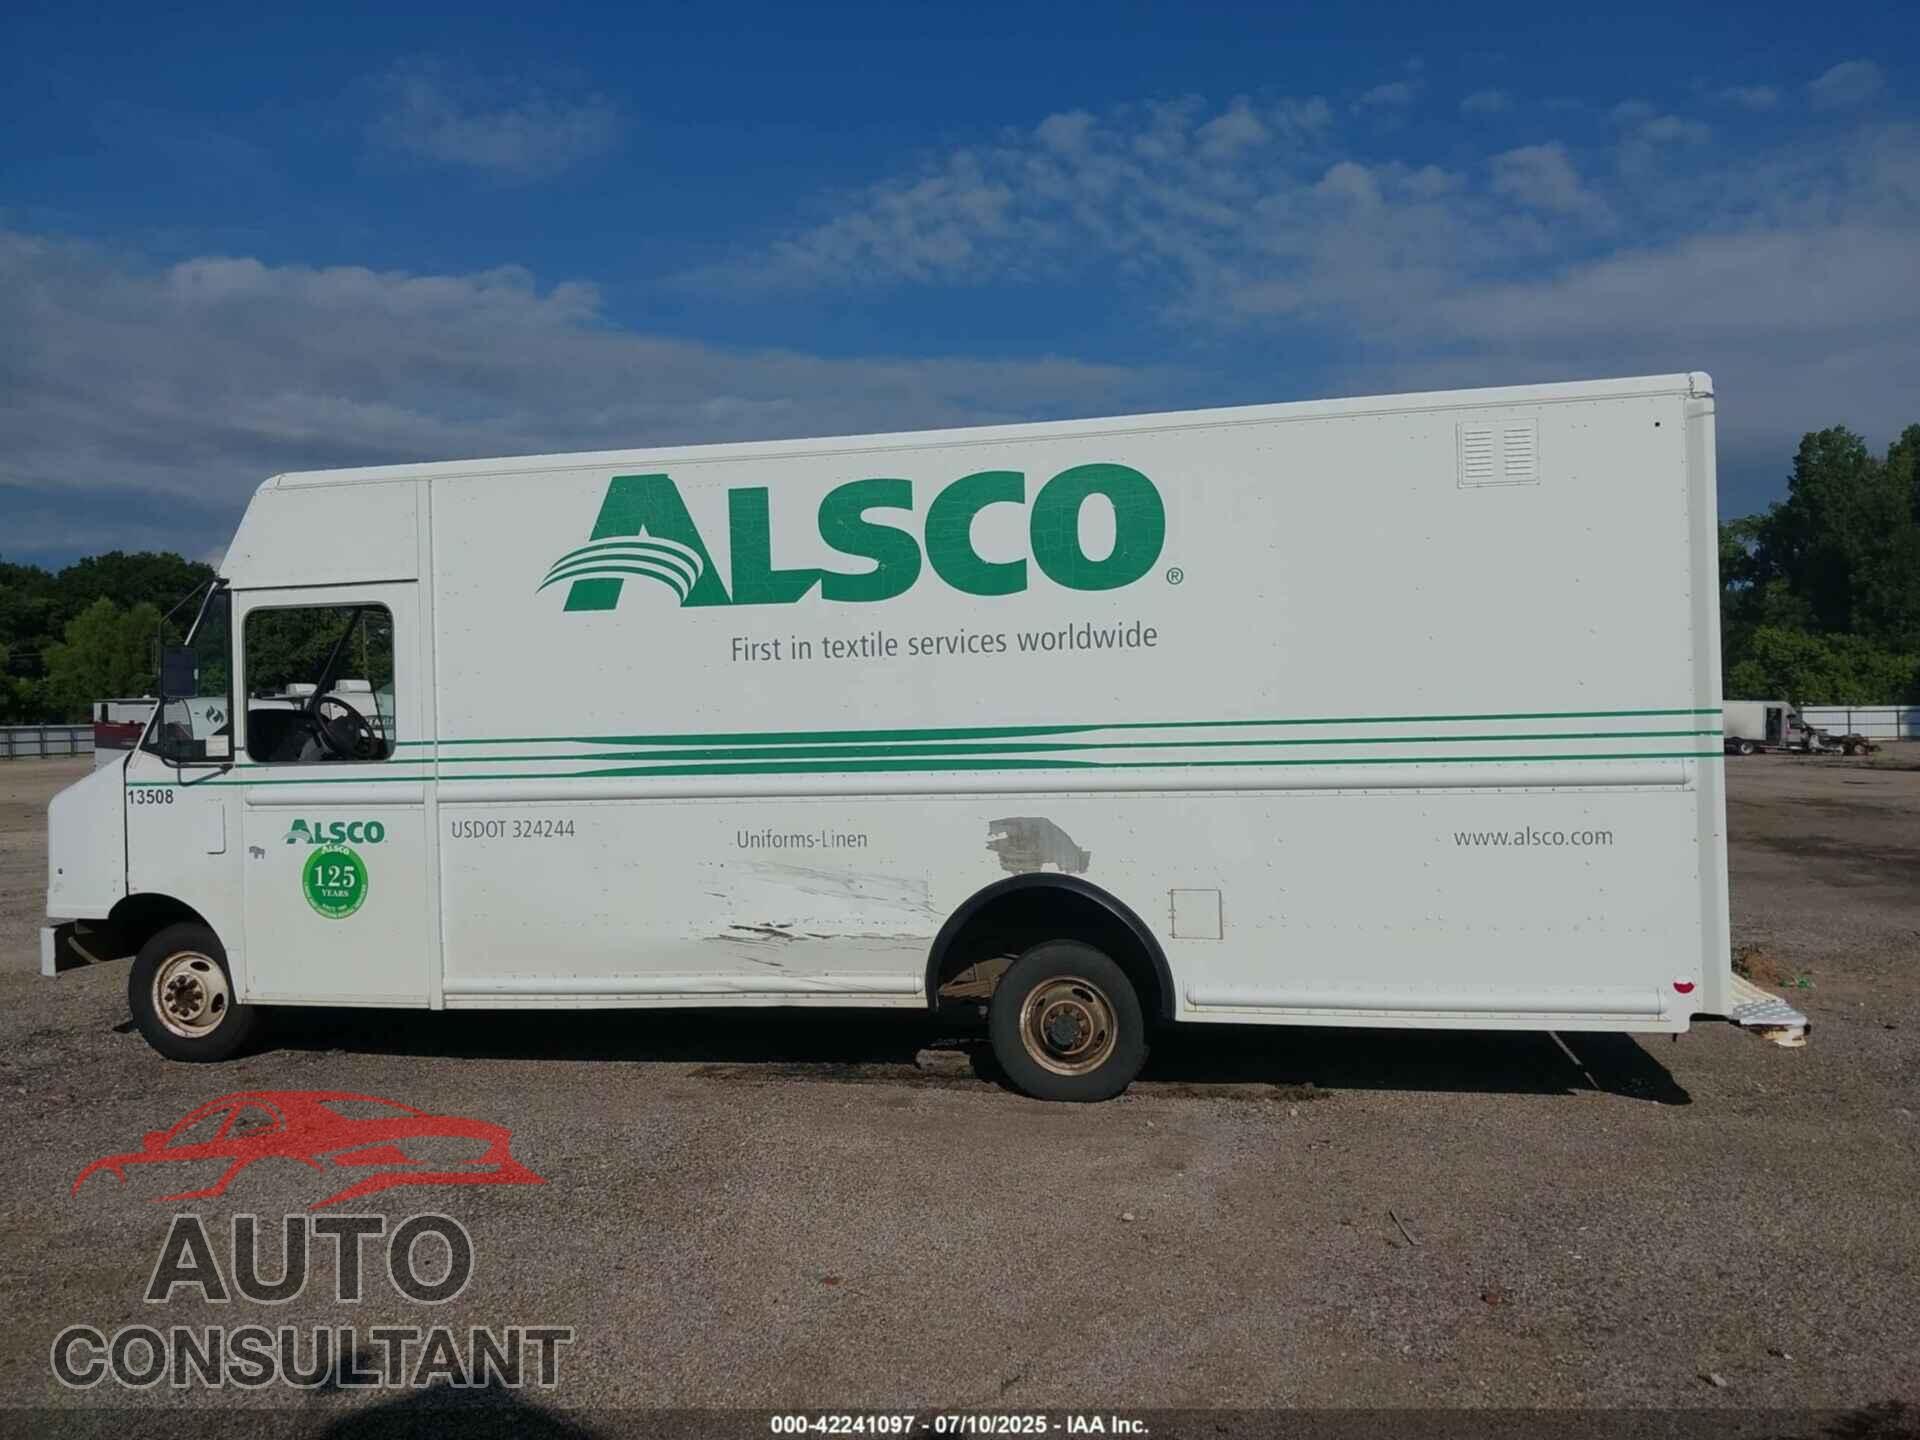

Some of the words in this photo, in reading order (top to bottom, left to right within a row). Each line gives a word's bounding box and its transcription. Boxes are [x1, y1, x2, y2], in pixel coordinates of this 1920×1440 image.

[536, 463, 1166, 611] ALSCO
[732, 636, 781, 661] First
[791, 635, 812, 660] in
[822, 630, 898, 658] textile
[908, 628, 1007, 655] services
[1017, 620, 1157, 651] worldwide
[128, 789, 174, 805] 13508
[284, 818, 385, 845] ALSCO
[451, 820, 507, 839] USDOT
[512, 819, 575, 838] 324244
[737, 828, 868, 849] Uniforms-Linen
[1454, 826, 1614, 847] www.alsco.com
[314, 865, 356, 888] 125
[321, 888, 349, 897] YEARS
